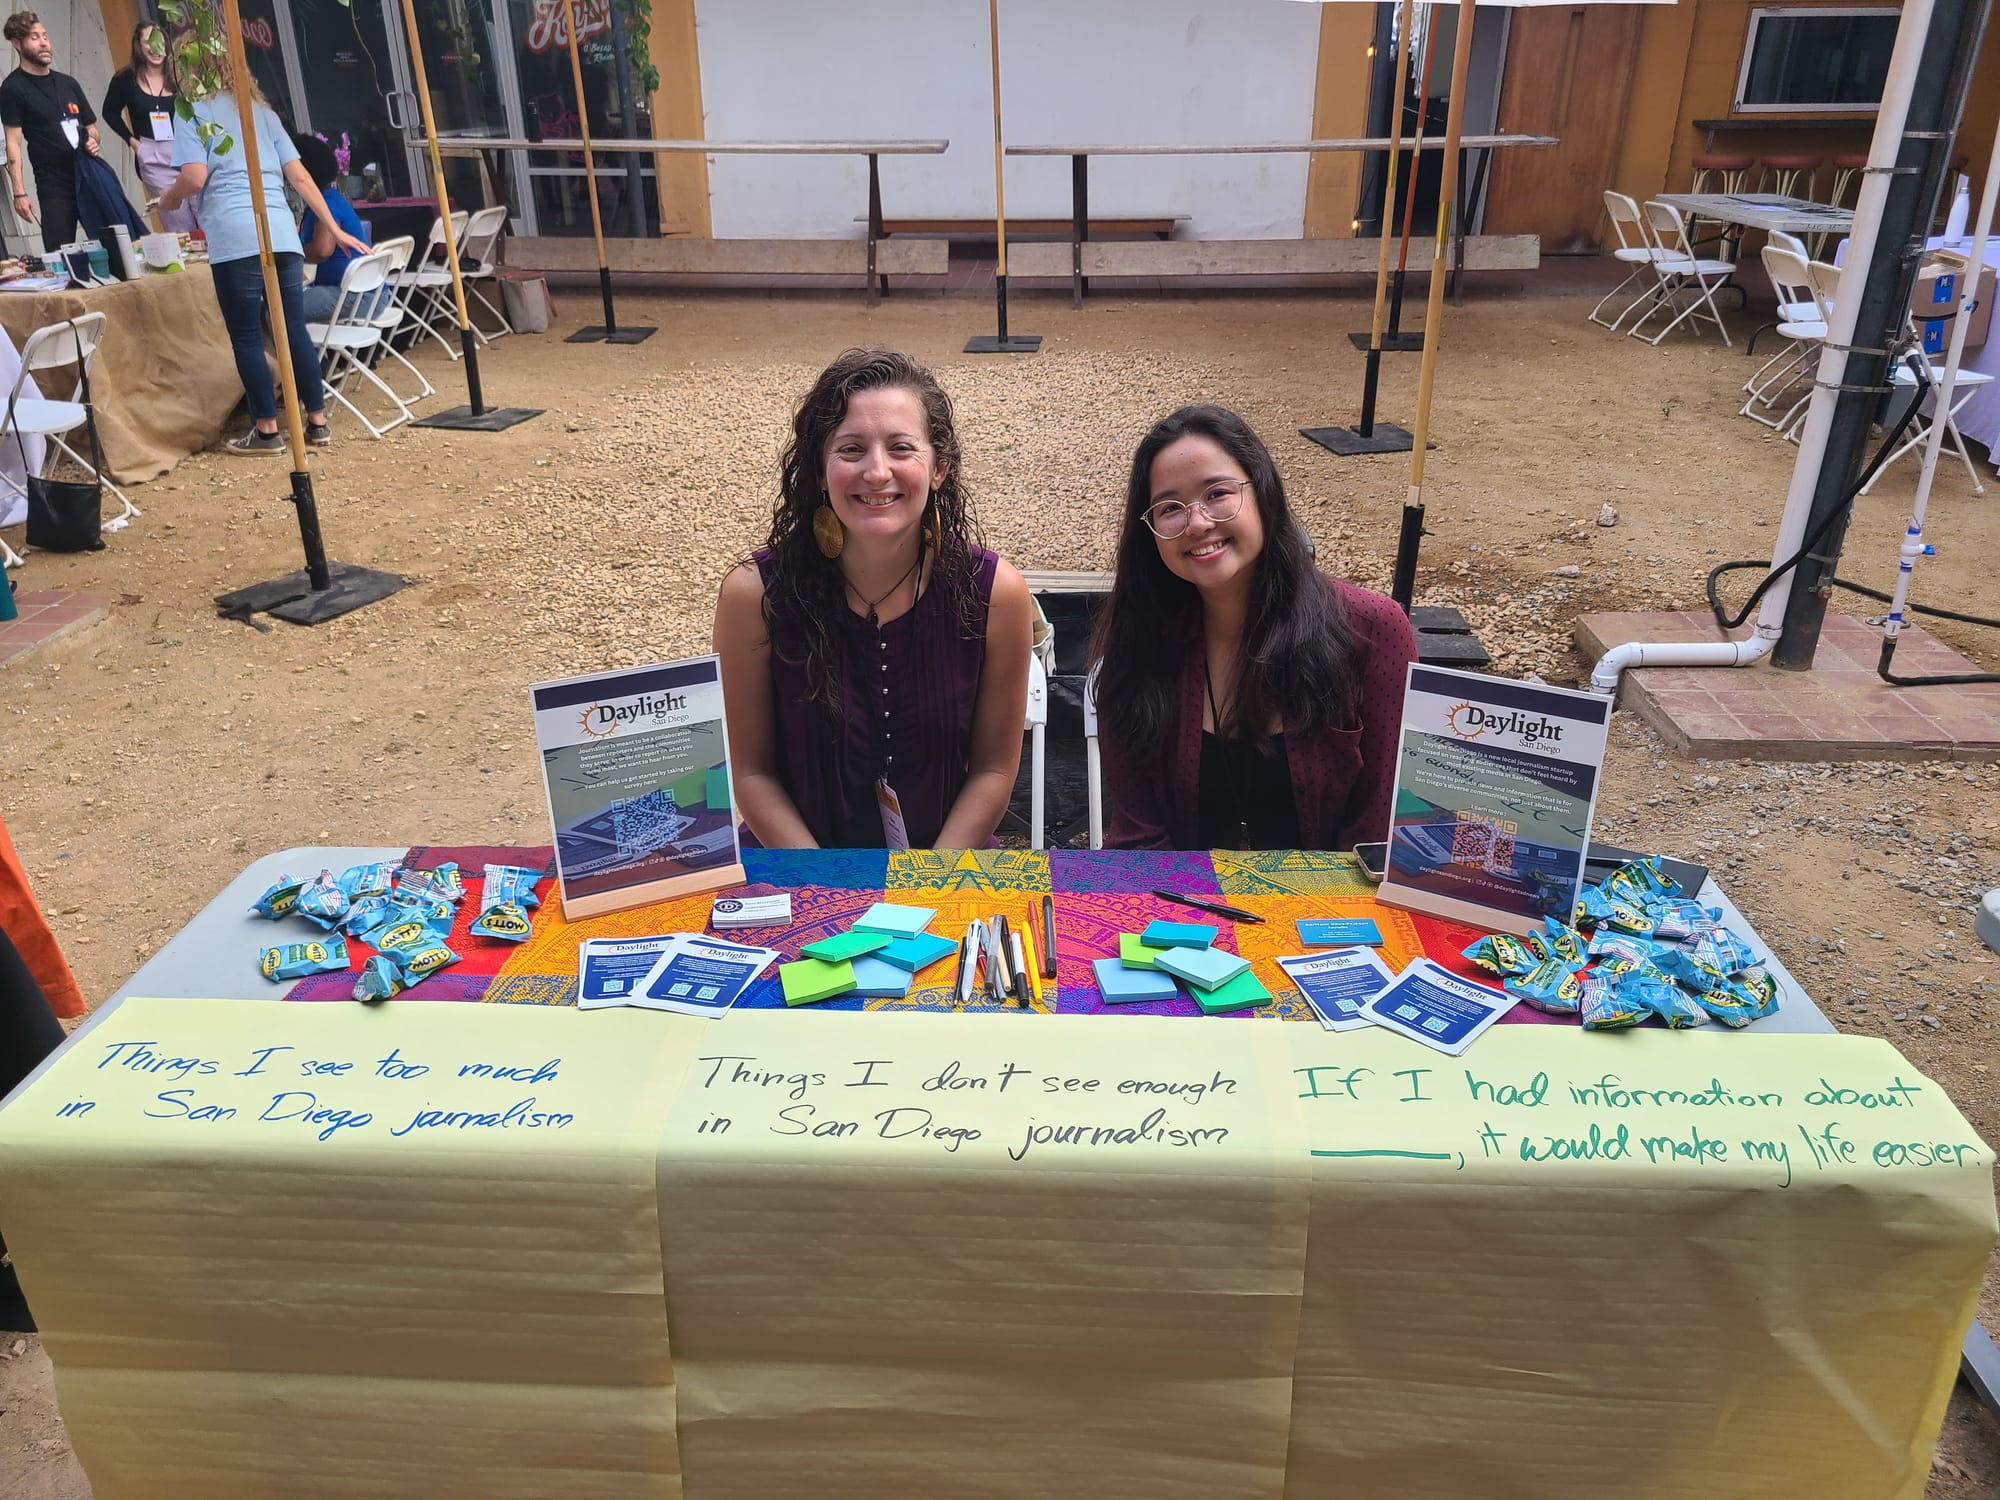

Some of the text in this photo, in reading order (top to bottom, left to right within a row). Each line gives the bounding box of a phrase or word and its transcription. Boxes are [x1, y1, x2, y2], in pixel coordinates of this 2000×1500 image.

[598, 692, 687, 724] Daylight
[651, 713, 690, 726] San Diego
[1466, 706, 1564, 742] Daylight
[579, 744, 609, 754] Journalism
[581, 753, 606, 761] between
[606, 748, 633, 757] reporters
[641, 750, 660, 758] report
[1518, 739, 1560, 755] San Diego
[1417, 747, 1441, 756] focused
[1506, 765, 1519, 773] that
[1520, 768, 1536, 776] don't
[1537, 771, 1550, 779] feel
[1550, 774, 1568, 782] heard
[1448, 745, 1460, 753] San
[1502, 756, 1517, 764] local
[1517, 759, 1550, 771] journalism
[1550, 767, 1574, 776] startup
[608, 778, 620, 786] help
[638, 771, 659, 780] started
[667, 766, 685, 774] taking
[1485, 769, 1504, 777] media
[623, 782, 643, 790] survey
[1416, 768, 1432, 777] We're
[1433, 772, 1447, 780] here
[1506, 788, 1542, 800] information
[1542, 796, 1556, 804] that
[1426, 778, 1447, 788] Diego's
[1448, 783, 1469, 793] diverse
[1521, 799, 1534, 807] just
[1534, 802, 1552, 810] about
[1471, 804, 1488, 813] Learn
[616, 942, 659, 951] Daylight
[708, 948, 749, 960] Daylight
[1310, 957, 1351, 970] Daylight
[1444, 979, 1487, 1001] Daylight
[97, 1042, 562, 1084] Things I see too much
[698, 1056, 1238, 1105] Things I don't see enough
[1293, 1067, 1922, 1109] If I had information about
[55, 1094, 96, 1118] in
[143, 1089, 237, 1123] San
[258, 1091, 373, 1143] Diego
[697, 1104, 1229, 1162] in San Diego journalism
[1476, 1121, 1508, 1158] it
[1520, 1123, 1632, 1162] would
[1639, 1126, 1728, 1165] make
[1741, 1138, 1792, 1188] my
[1797, 1121, 1857, 1170] life
[1872, 1139, 1981, 1168] easier.
